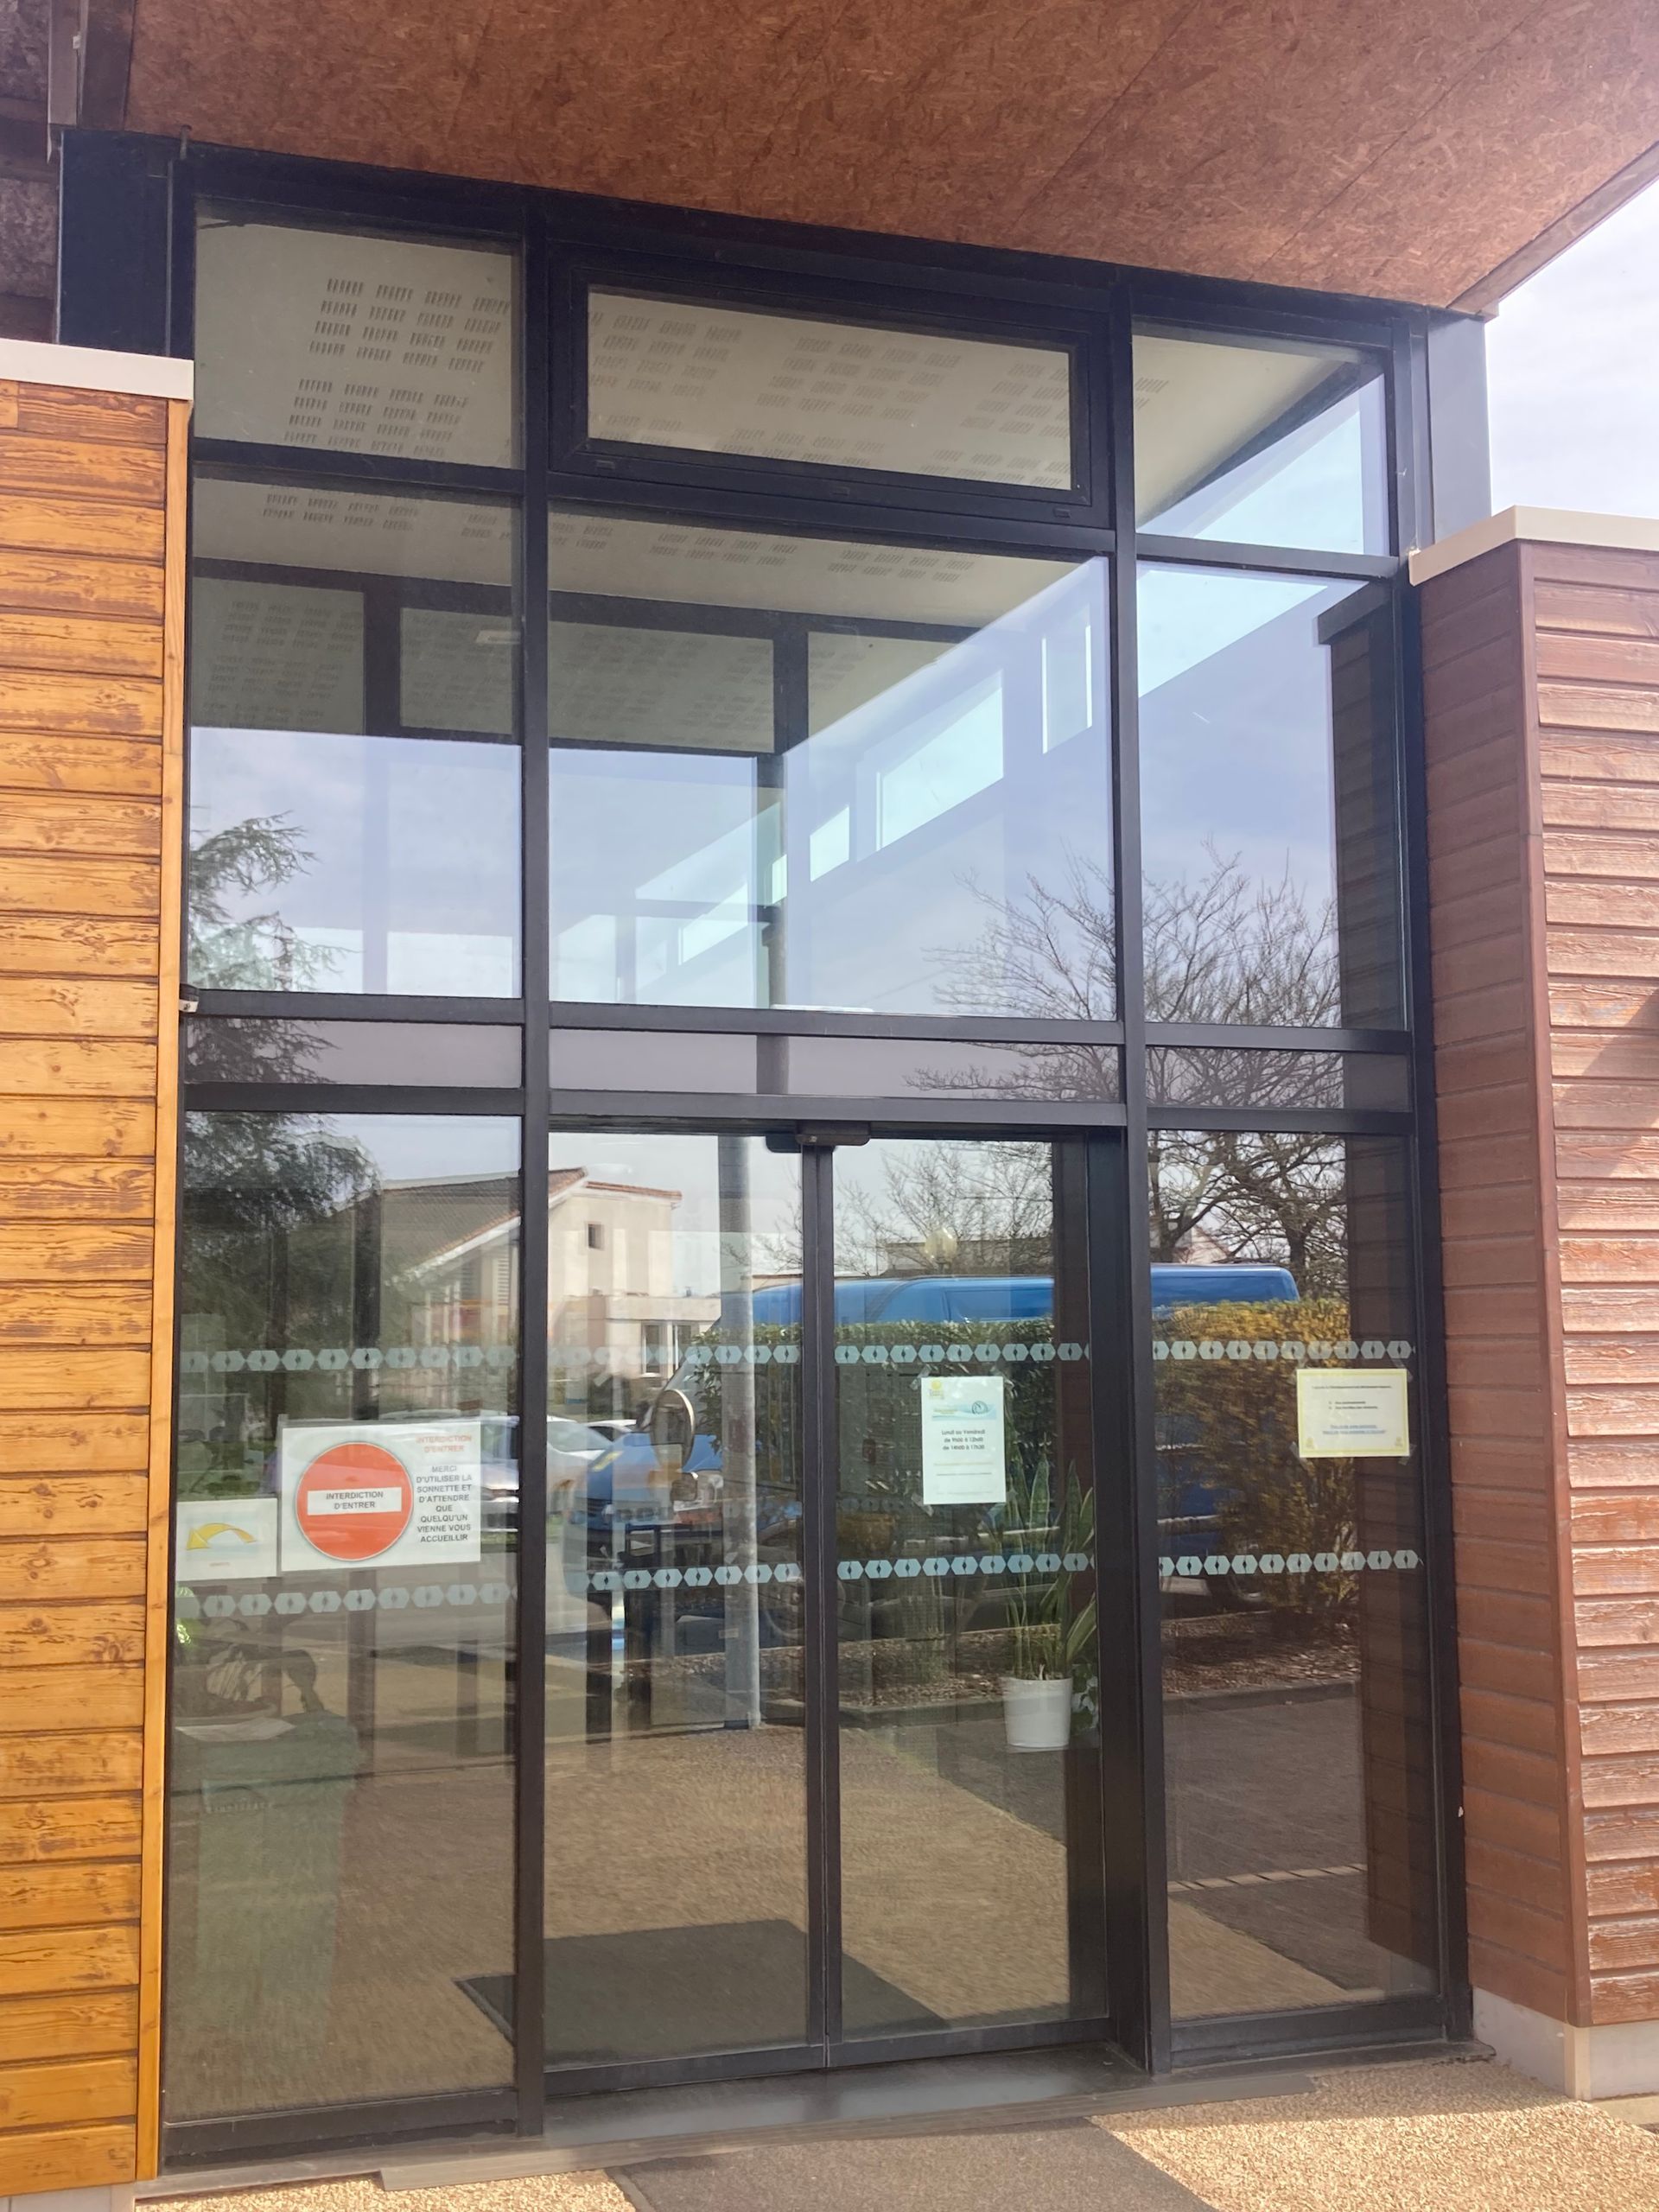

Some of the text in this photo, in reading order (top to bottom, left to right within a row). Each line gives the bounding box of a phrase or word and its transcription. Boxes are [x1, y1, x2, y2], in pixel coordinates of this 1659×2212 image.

[416, 1475, 460, 1484] D'UTILISER
[418, 1494, 470, 1503] D'ATTENDRE
[334, 1501, 375, 1510] D'ENTRER
[420, 1514, 468, 1522] QUELQU'UN
[416, 1524, 447, 1533] VIENNE
[420, 1534, 468, 1543] ACCUEILLIR
